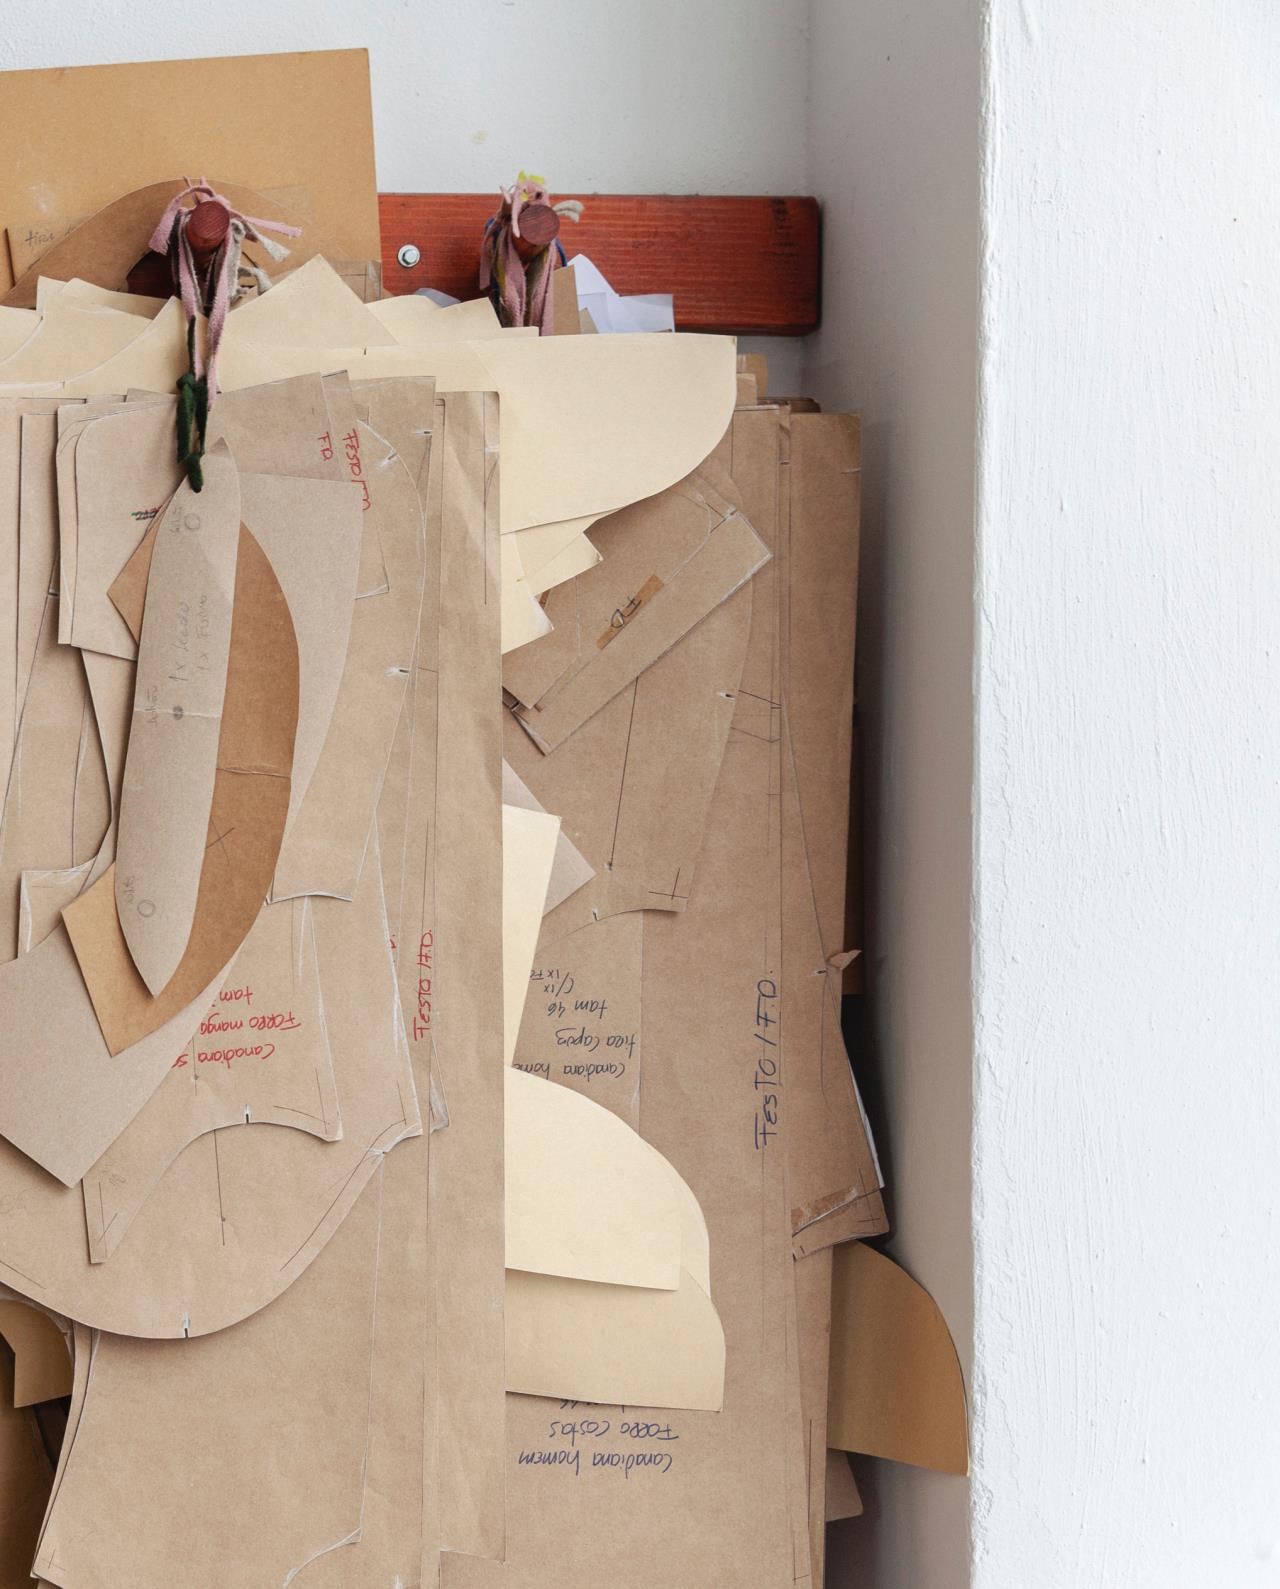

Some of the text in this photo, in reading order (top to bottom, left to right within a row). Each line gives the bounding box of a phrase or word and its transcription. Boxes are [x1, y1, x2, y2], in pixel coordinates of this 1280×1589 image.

[219, 986, 254, 1005] tam
[547, 999, 608, 1019] tam 46
[200, 1012, 244, 1035] manga
[197, 1043, 276, 1069] Canadiana
[563, 1062, 626, 1083] Canadiana
[518, 1450, 673, 1480] Canadiana homem
